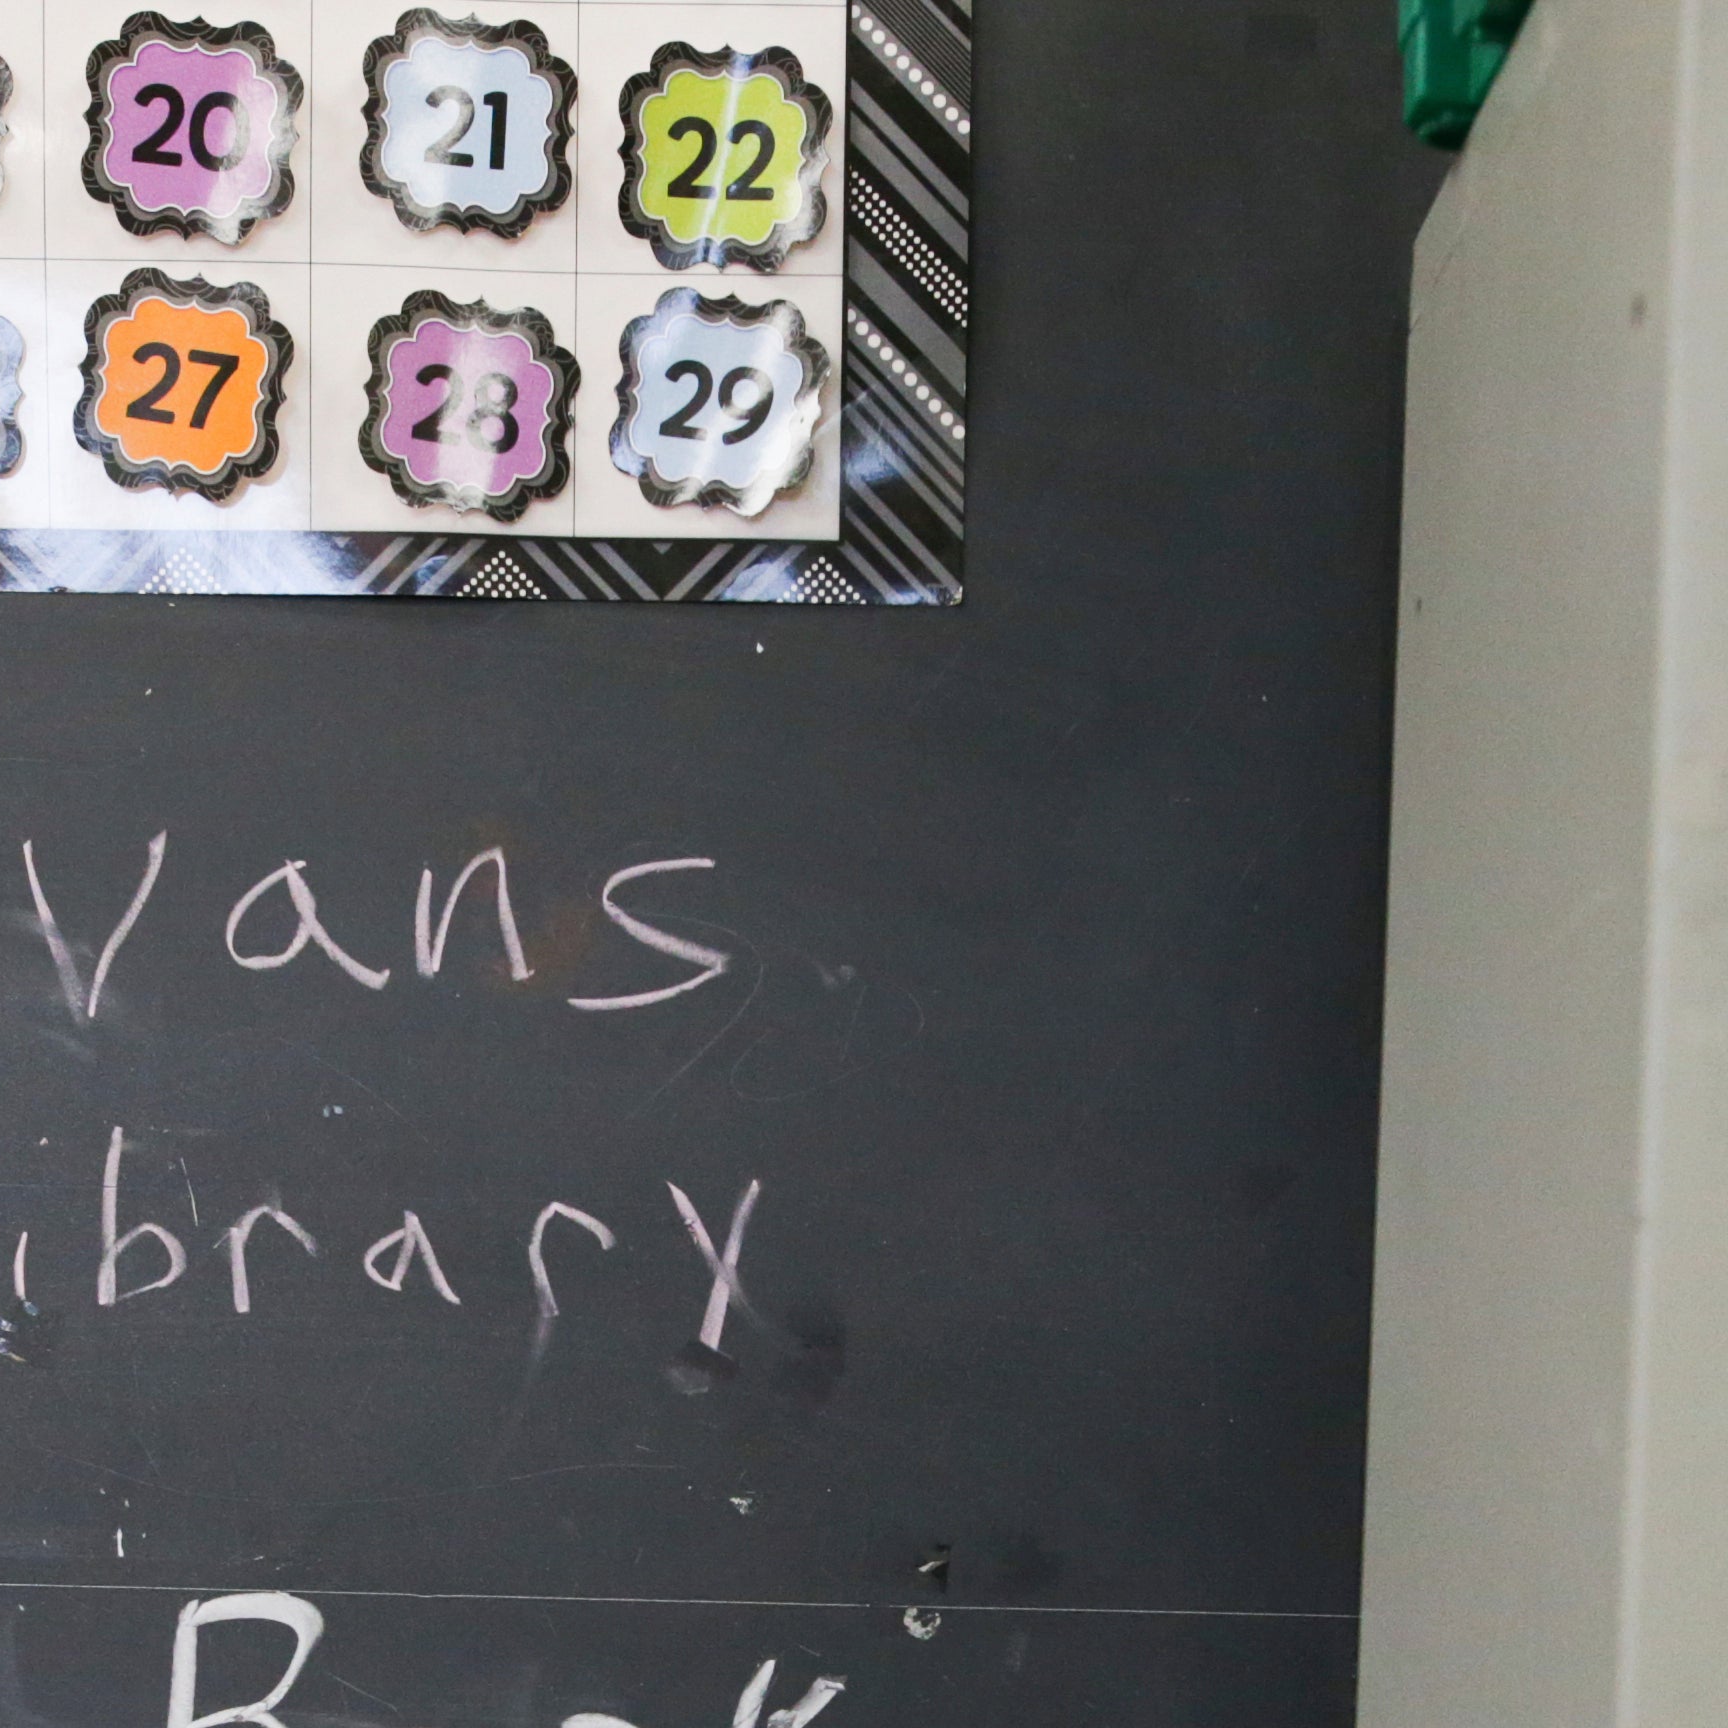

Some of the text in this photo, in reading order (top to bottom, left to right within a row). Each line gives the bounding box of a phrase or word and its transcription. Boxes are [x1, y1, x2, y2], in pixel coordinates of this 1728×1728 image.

[132, 83, 245, 171] 20
[424, 85, 506, 171] 21
[668, 115, 775, 200] 22
[127, 341, 240, 429] 27
[413, 363, 519, 454] 28
[659, 361, 774, 447] 29
